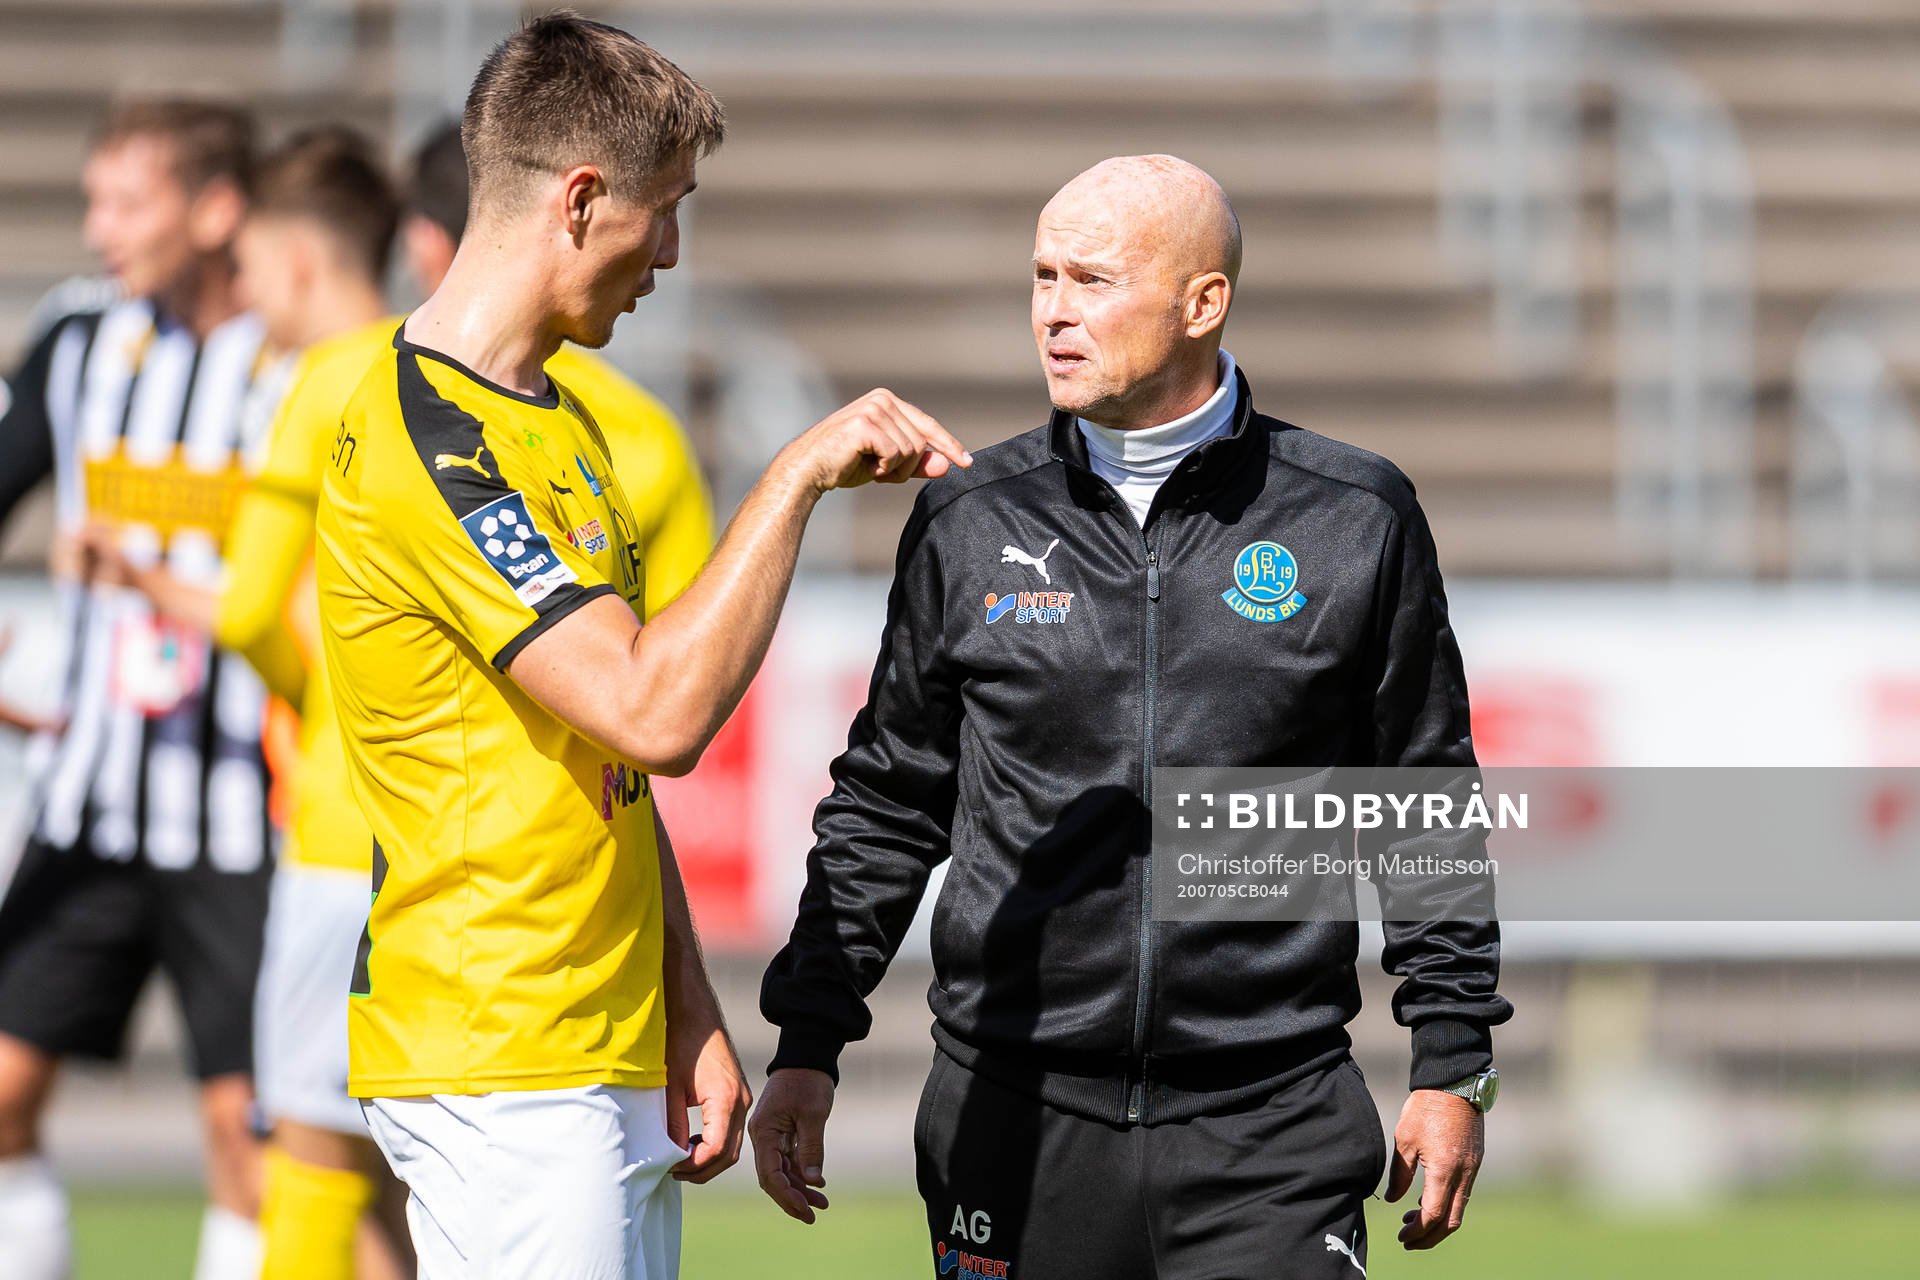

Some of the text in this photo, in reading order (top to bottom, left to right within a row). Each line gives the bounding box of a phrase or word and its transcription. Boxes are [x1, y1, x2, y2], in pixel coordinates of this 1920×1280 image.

[576, 519, 602, 541] INTER
[584, 533, 609, 555] SPORT
[1239, 563, 1251, 577] 19
[1281, 566, 1293, 579] 19
[1017, 591, 1072, 608] INTER
[1227, 592, 1301, 621] LUNDS BK
[1015, 607, 1071, 624] SPORT
[949, 1204, 991, 1244] AG
[959, 1250, 1007, 1277] INTER
